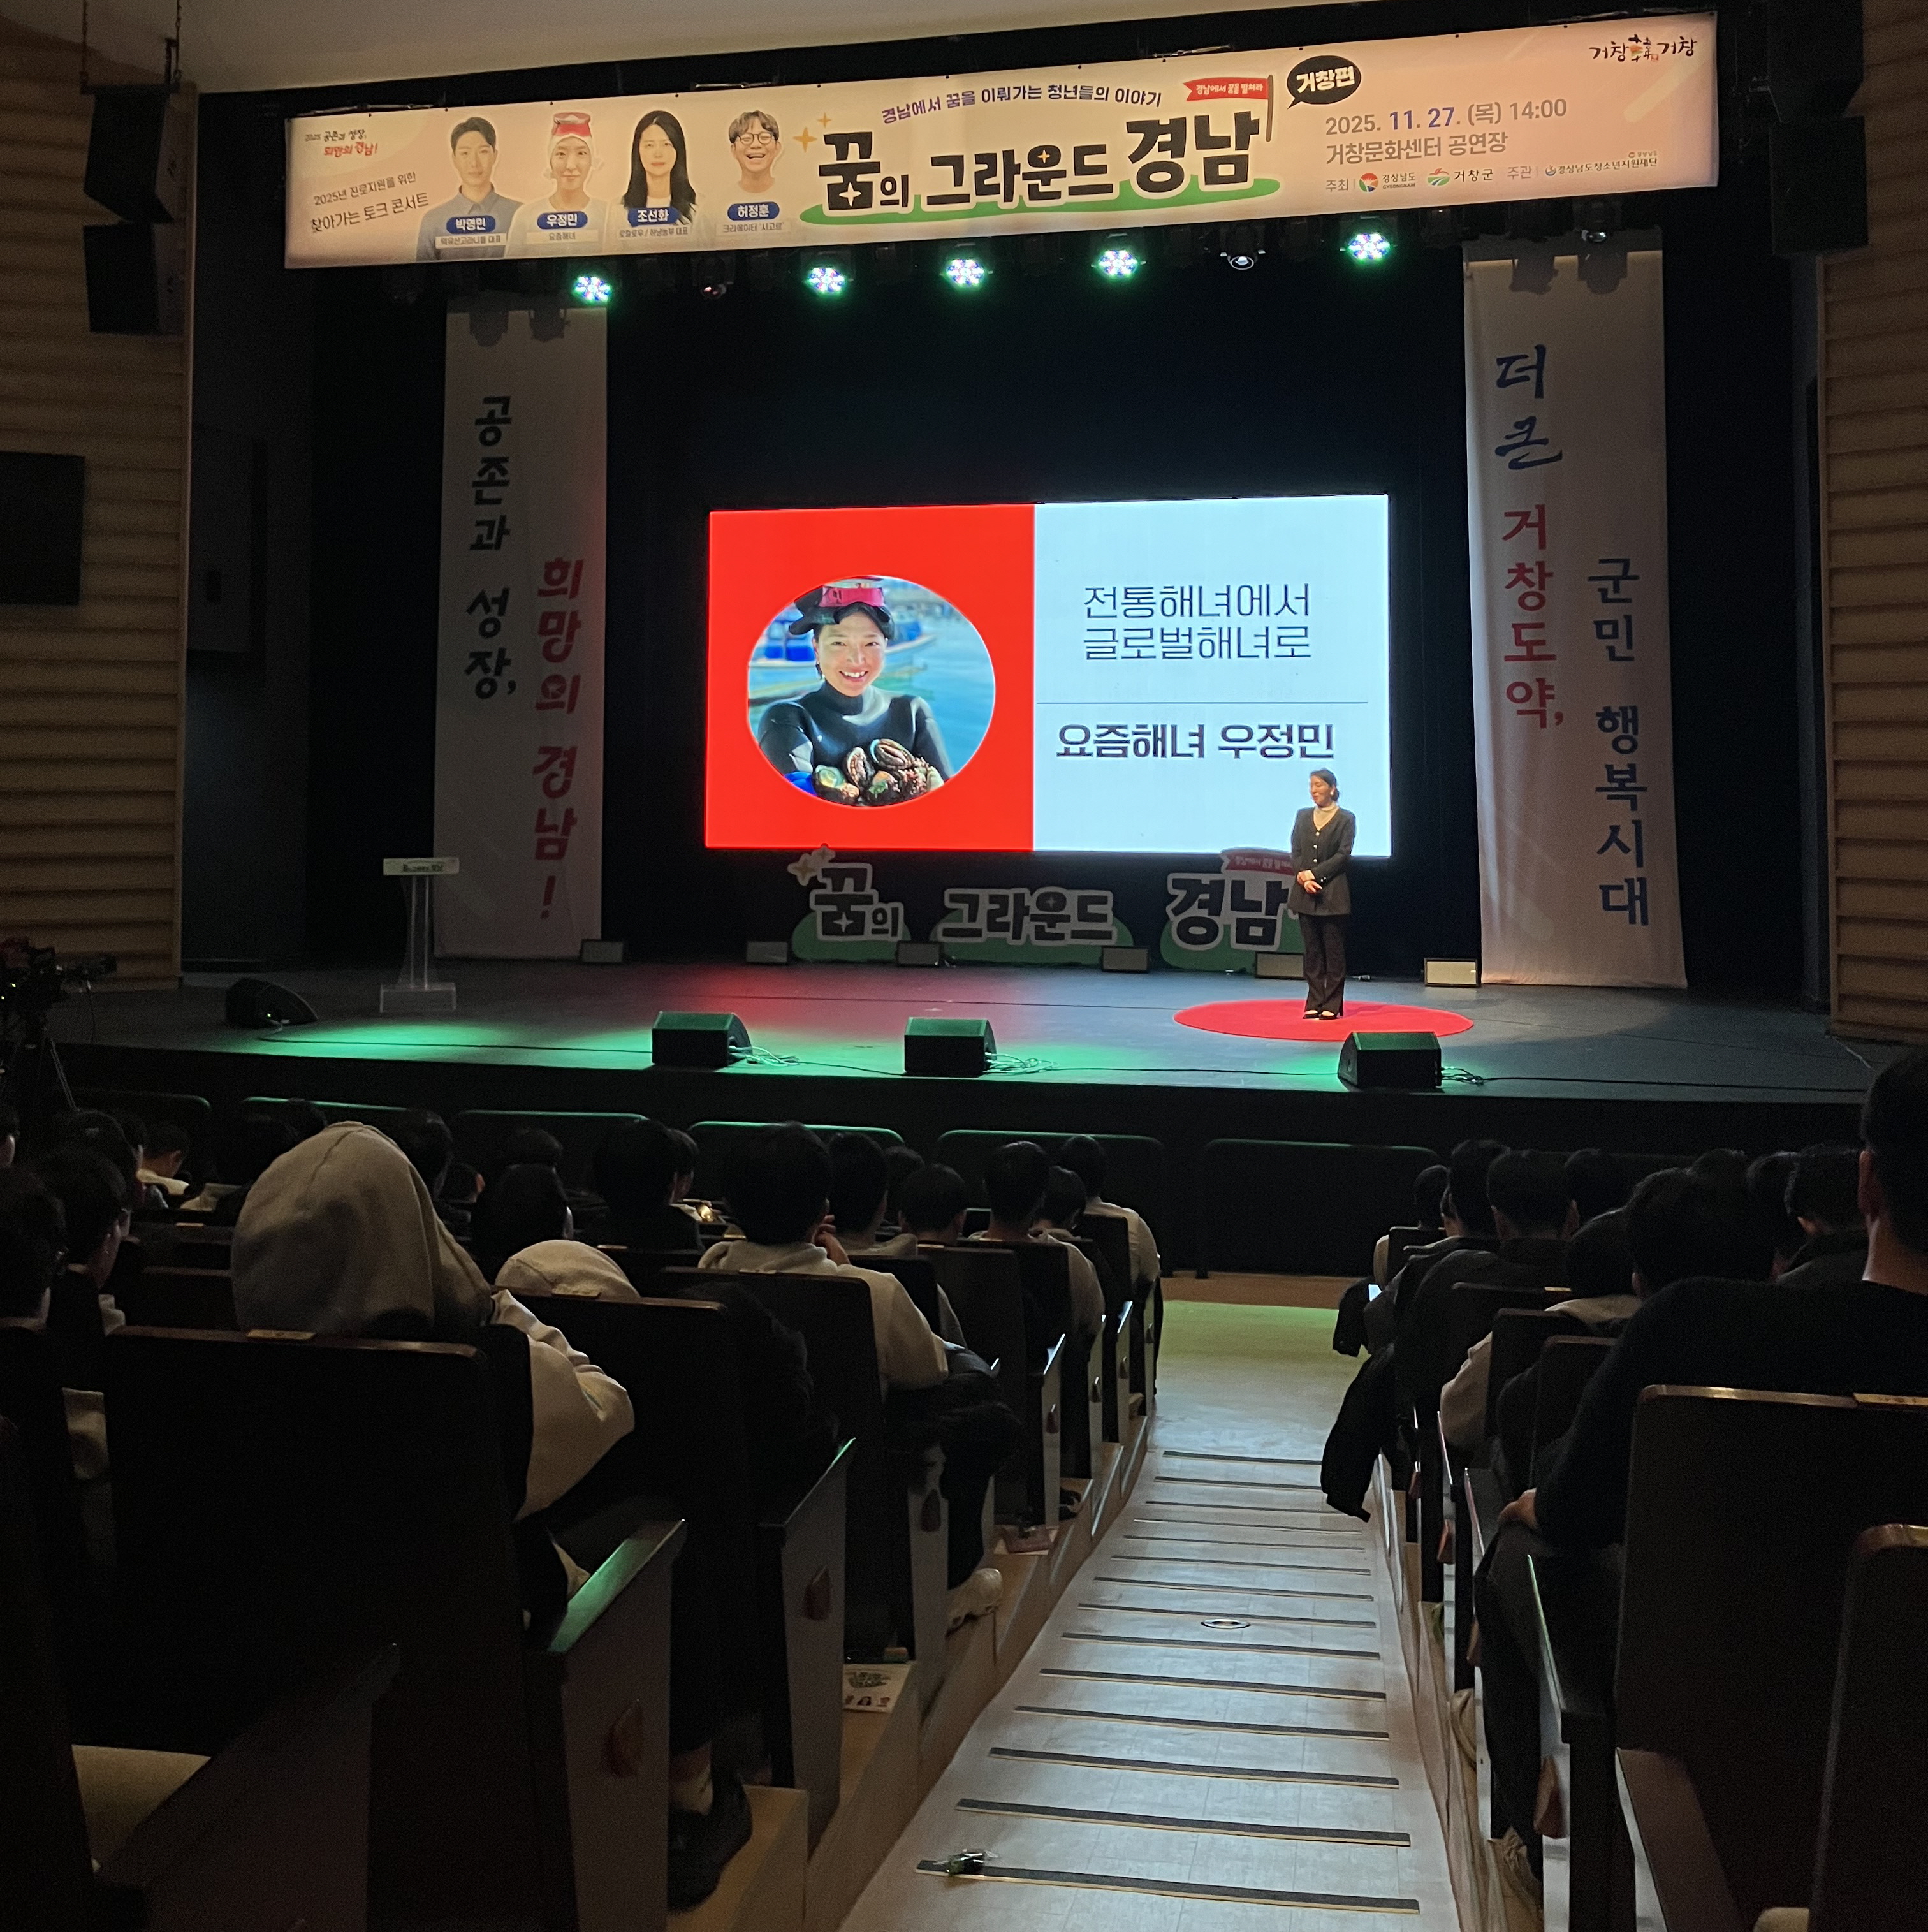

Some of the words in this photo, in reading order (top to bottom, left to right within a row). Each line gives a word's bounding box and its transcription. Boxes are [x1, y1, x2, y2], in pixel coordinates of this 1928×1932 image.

[1196, 84, 1227, 95] 경남에서
[1227, 83, 1239, 94] 꿈을
[1296, 66, 1355, 93] 거창편
[882, 96, 942, 124] 경남에서
[946, 91, 975, 108] 꿈을
[981, 85, 1042, 103] 이뤄가는
[1048, 84, 1110, 101] 청년들의
[1114, 88, 1162, 108] 이야기
[1326, 113, 1382, 135] 2025.
[1389, 110, 1421, 130] 11.
[1428, 106, 1461, 128] 27.
[1468, 101, 1502, 126] (목)
[1510, 98, 1567, 121] 14:00
[819, 131, 909, 211] 꿈의
[926, 144, 1114, 206] 그라운드
[1126, 111, 1260, 193] 경남
[1326, 136, 1442, 165] 거창문화센터
[1449, 131, 1508, 156] 공연장
[314, 189, 347, 205] 2025년
[350, 177, 395, 198] 진로지원을
[398, 171, 416, 186] 위한
[1326, 178, 1349, 192] 주최
[1382, 172, 1416, 183] 경상남도
[1454, 168, 1494, 182] 거창군
[1507, 166, 1532, 180] 주관
[311, 210, 360, 234] 찾아가는
[363, 202, 390, 221] 토크
[391, 192, 429, 214] 콘서트
[455, 217, 486, 231] 박영민
[546, 213, 578, 227] 우정민
[637, 209, 669, 223] 조선화
[723, 223, 757, 233] 크리에이터
[738, 203, 770, 218] 허정훈
[1496, 344, 1547, 399] 더
[1494, 415, 1563, 471] 큰
[469, 395, 512, 551] 공존과
[1083, 582, 1310, 620] 전통해녀에서
[1501, 504, 1564, 729] 거창도약,
[1587, 557, 1640, 662] 군민
[464, 587, 517, 700] 성장,
[534, 557, 585, 715] 희망의
[1083, 626, 1311, 661] 글로벌해녀로
[1056, 724, 1205, 759] 요즘해녀
[1218, 724, 1334, 759] 우정민
[533, 745, 578, 920] 경남!
[1595, 705, 1649, 926] 행복시대
[814, 867, 900, 937] 꿈의
[942, 891, 1113, 941] 그라운드
[1171, 877, 1289, 946] 경남
